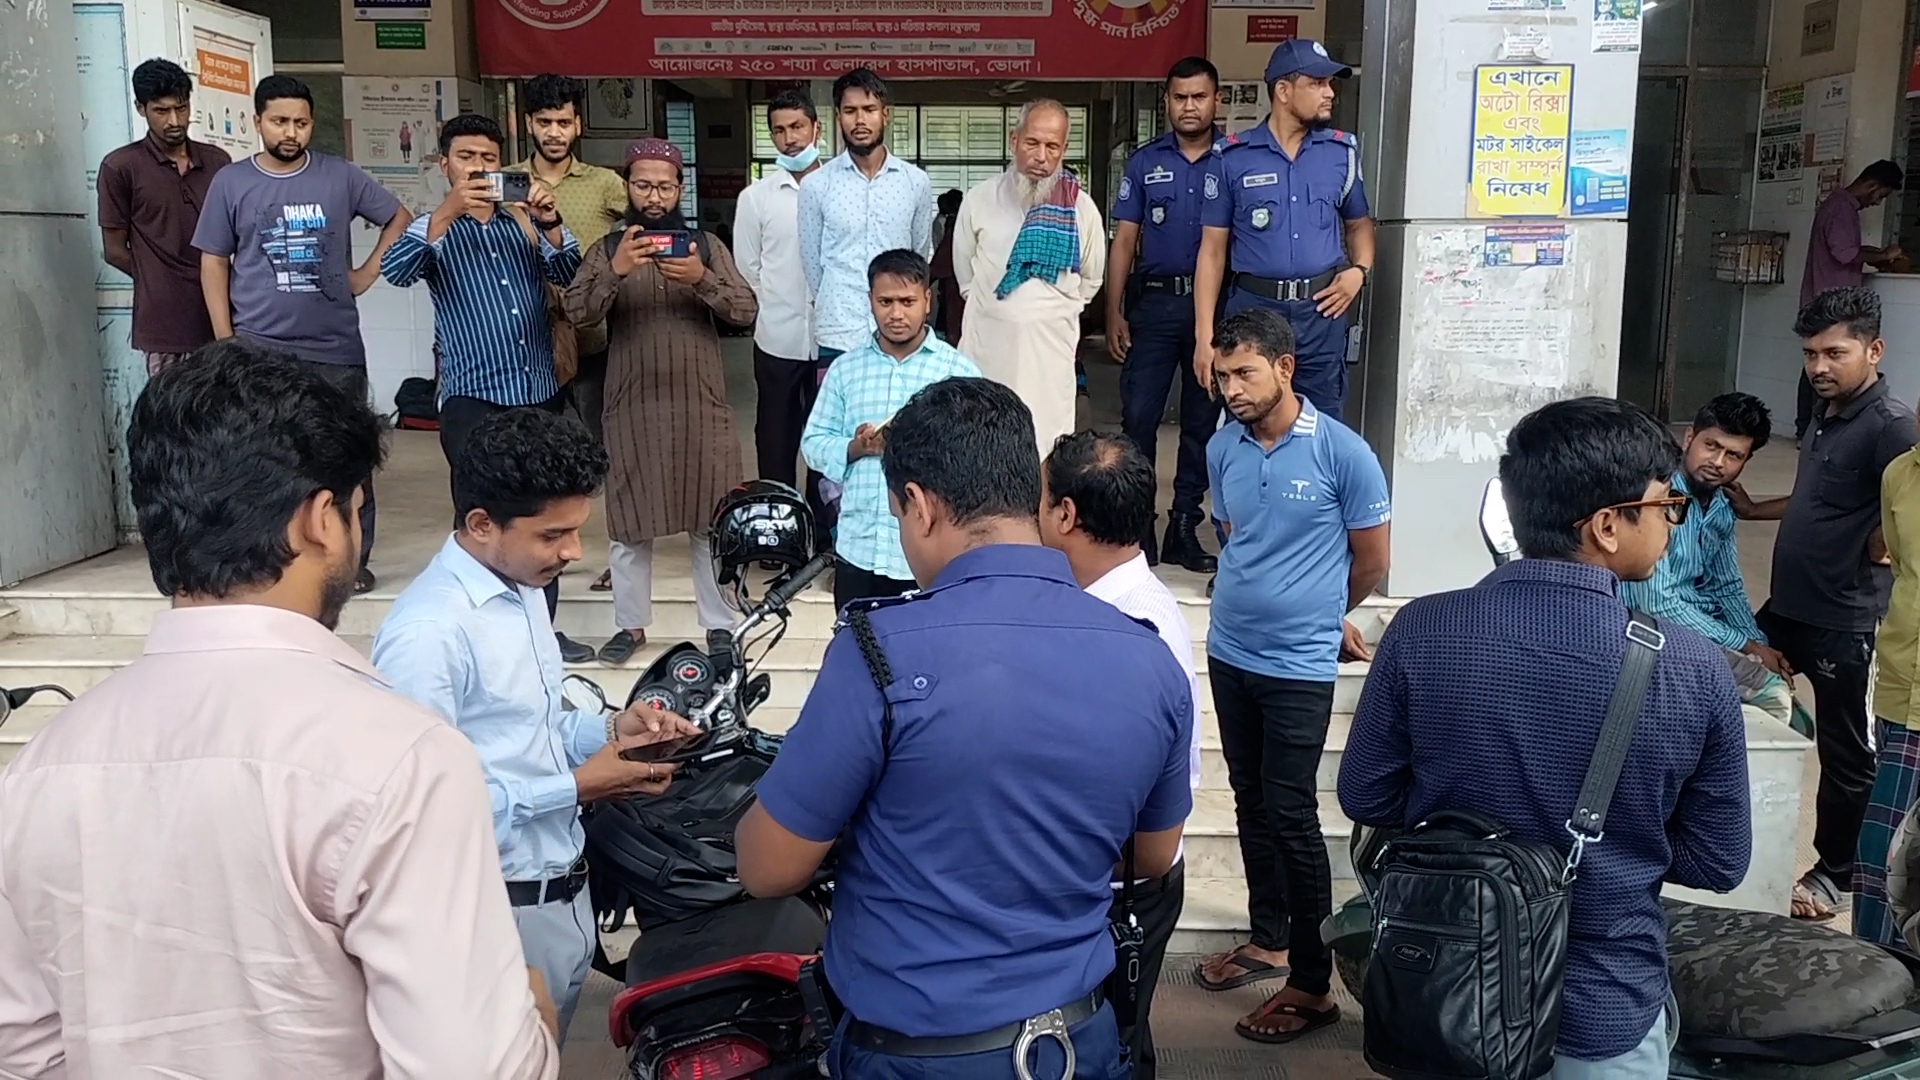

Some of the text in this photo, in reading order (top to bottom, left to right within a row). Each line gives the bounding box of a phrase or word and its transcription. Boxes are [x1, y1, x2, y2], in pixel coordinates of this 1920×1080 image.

[513, 0, 589, 19] feeding Support
[1067, 0, 1180, 38] দুগ্ধ পান নিশ্চিত
[648, 58, 734, 72] আয়োজনেঃ
[740, 59, 776, 73] ২৫০
[896, 58, 980, 74] হাসপাতাল,
[1489, 70, 1561, 86] এখানে
[1479, 91, 1520, 112] অটো
[1503, 116, 1541, 132] এবং
[1476, 134, 1506, 152] মটর
[1510, 134, 1565, 154] সাইকেল
[1476, 160, 1510, 176] রাখা
[1486, 178, 1550, 198] নিষেধ
[283, 204, 324, 222] DHAKA
[288, 216, 327, 228] THE CITY
